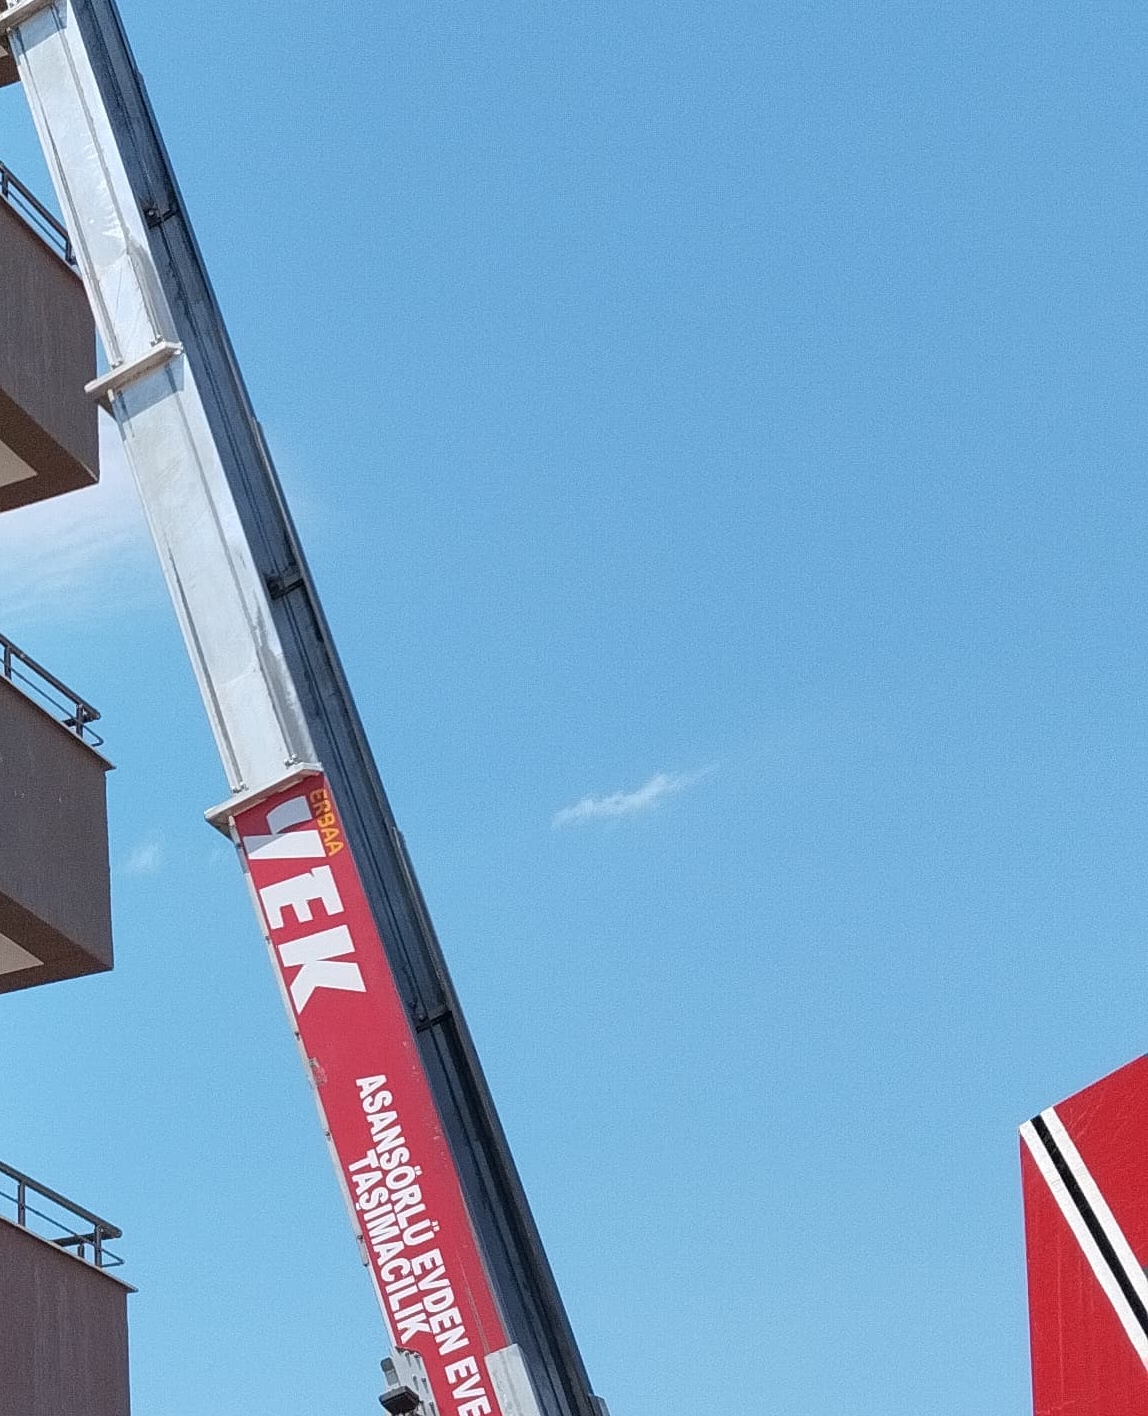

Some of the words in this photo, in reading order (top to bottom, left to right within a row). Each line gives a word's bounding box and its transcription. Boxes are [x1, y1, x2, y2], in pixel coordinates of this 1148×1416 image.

[243, 796, 367, 1015] YEK
[310, 788, 344, 857] ERBAA
[348, 1149, 432, 1345] TAŞIMACILIK
[356, 1073, 440, 1247] ASANSÖRLÜ
[411, 1248, 470, 1356] EVDEN
